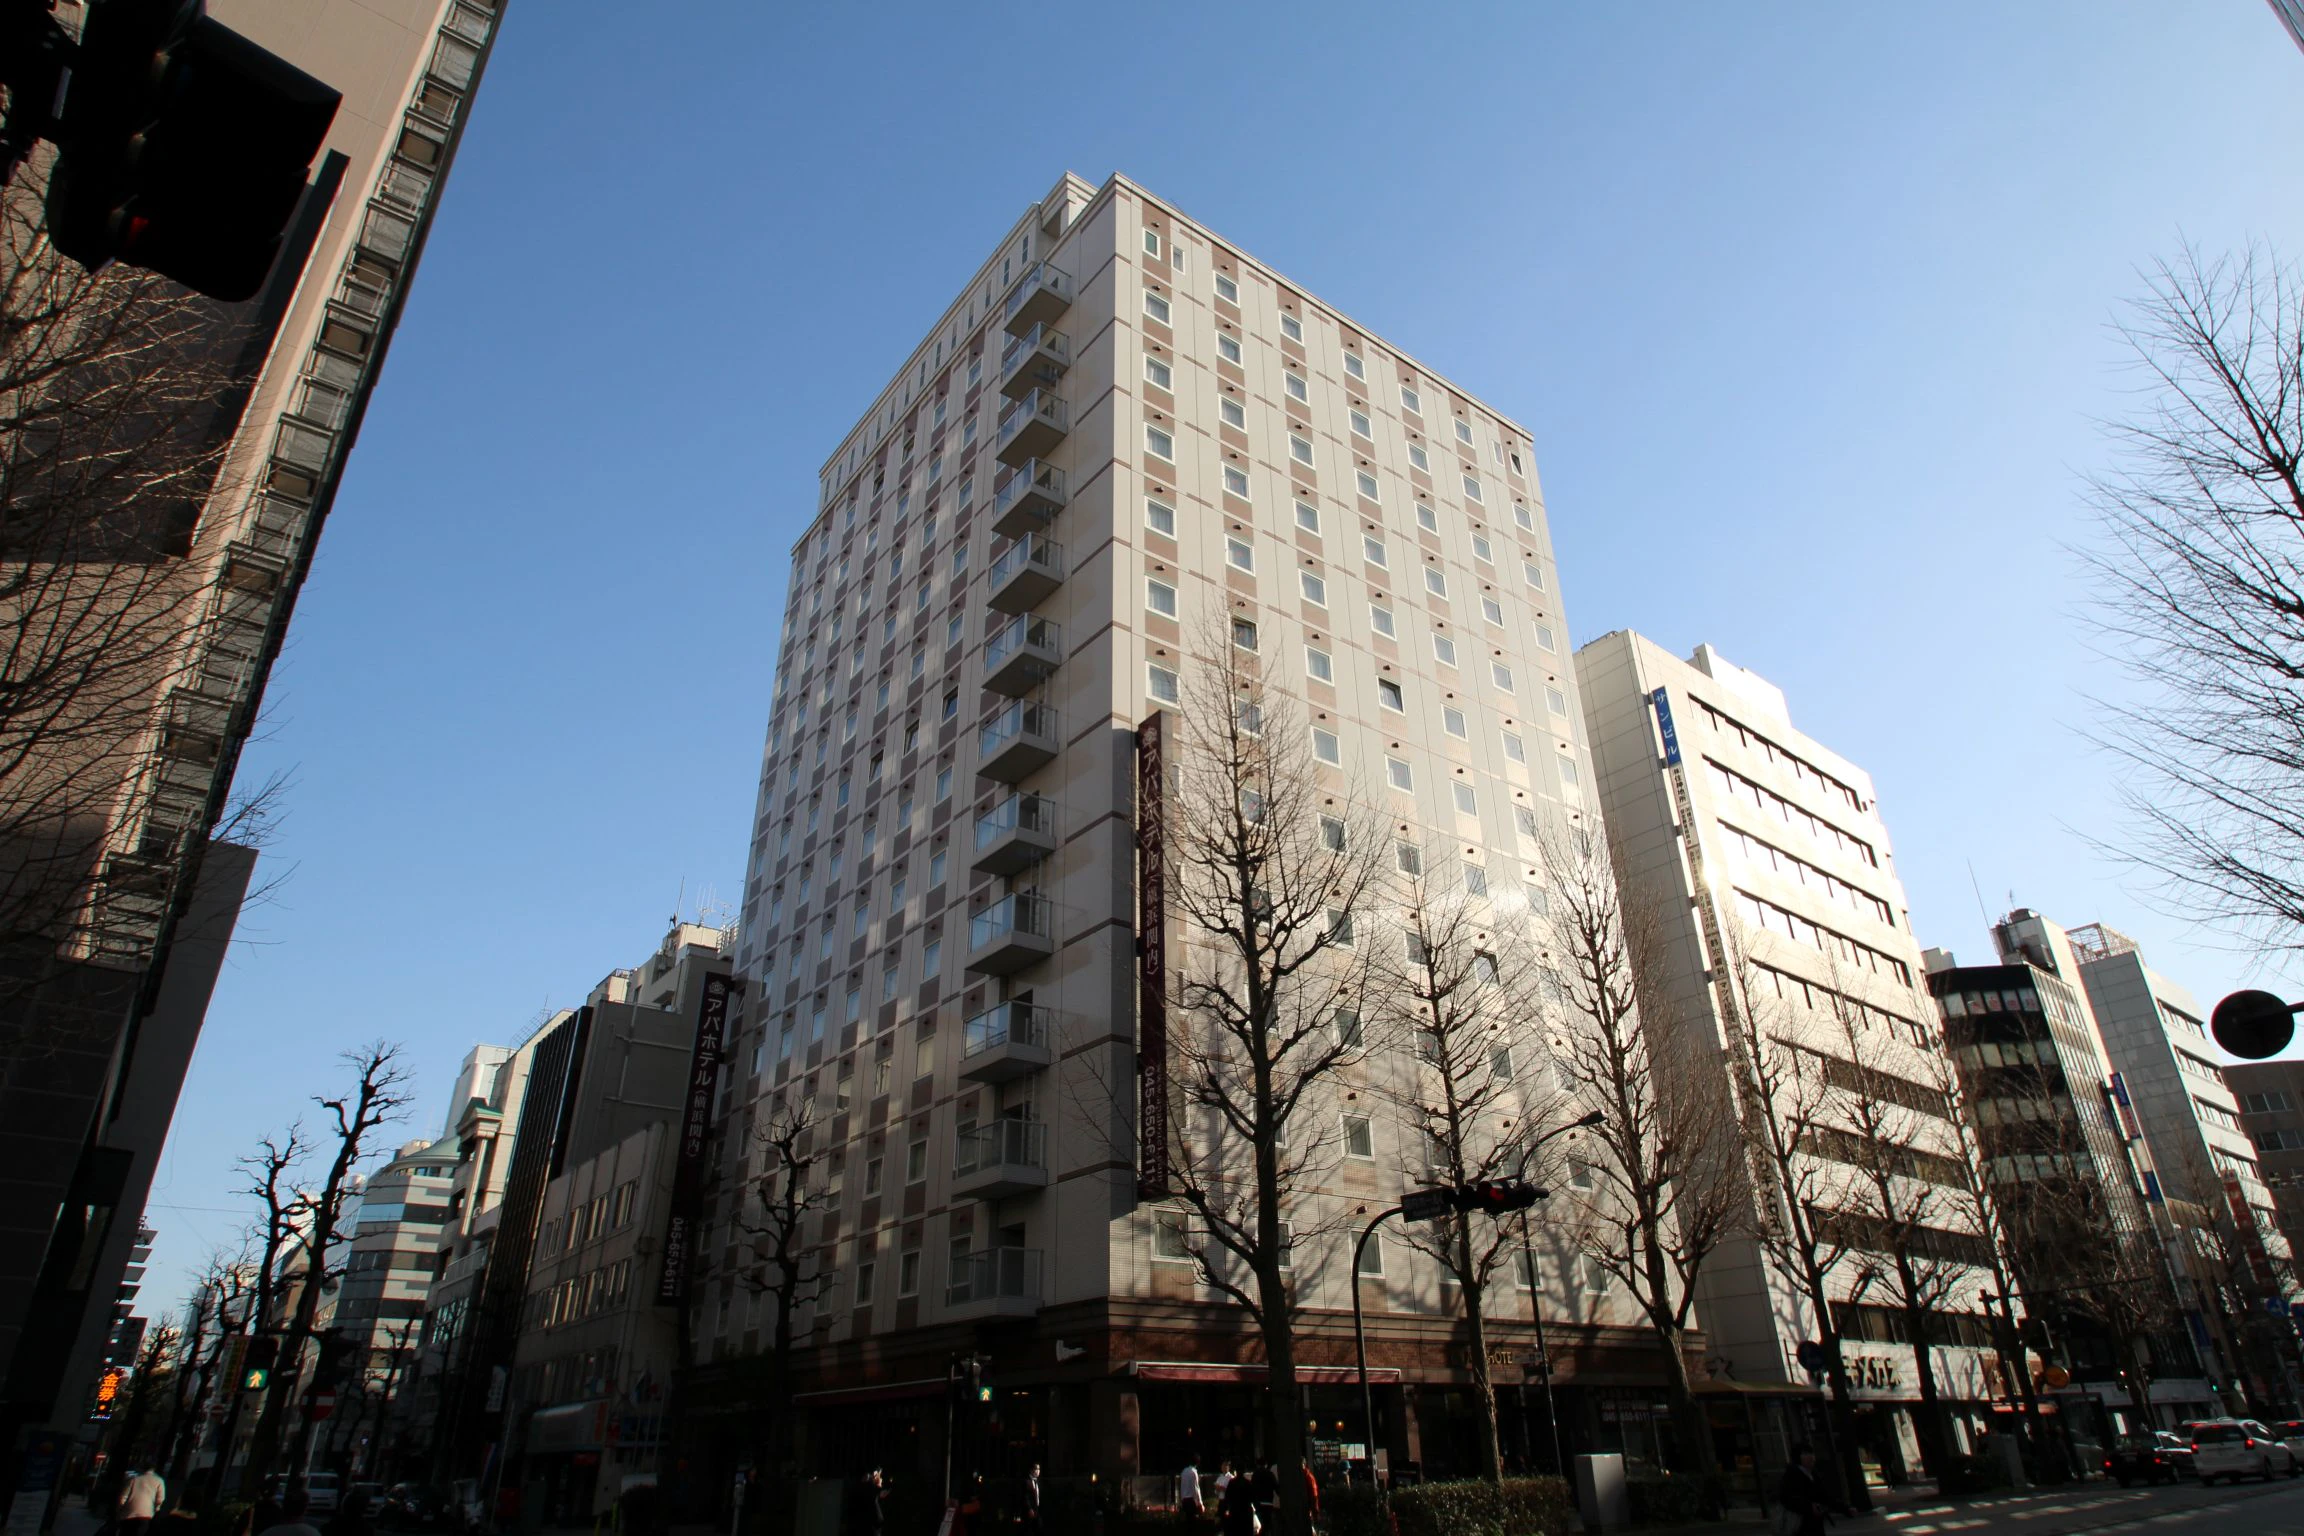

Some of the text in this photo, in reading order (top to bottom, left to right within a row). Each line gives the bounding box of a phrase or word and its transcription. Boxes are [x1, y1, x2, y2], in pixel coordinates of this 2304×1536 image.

[1655, 693, 1678, 757] サンビル
[662, 1216, 684, 1297] 045-650-6111
[98, 1372, 120, 1401] 金券
